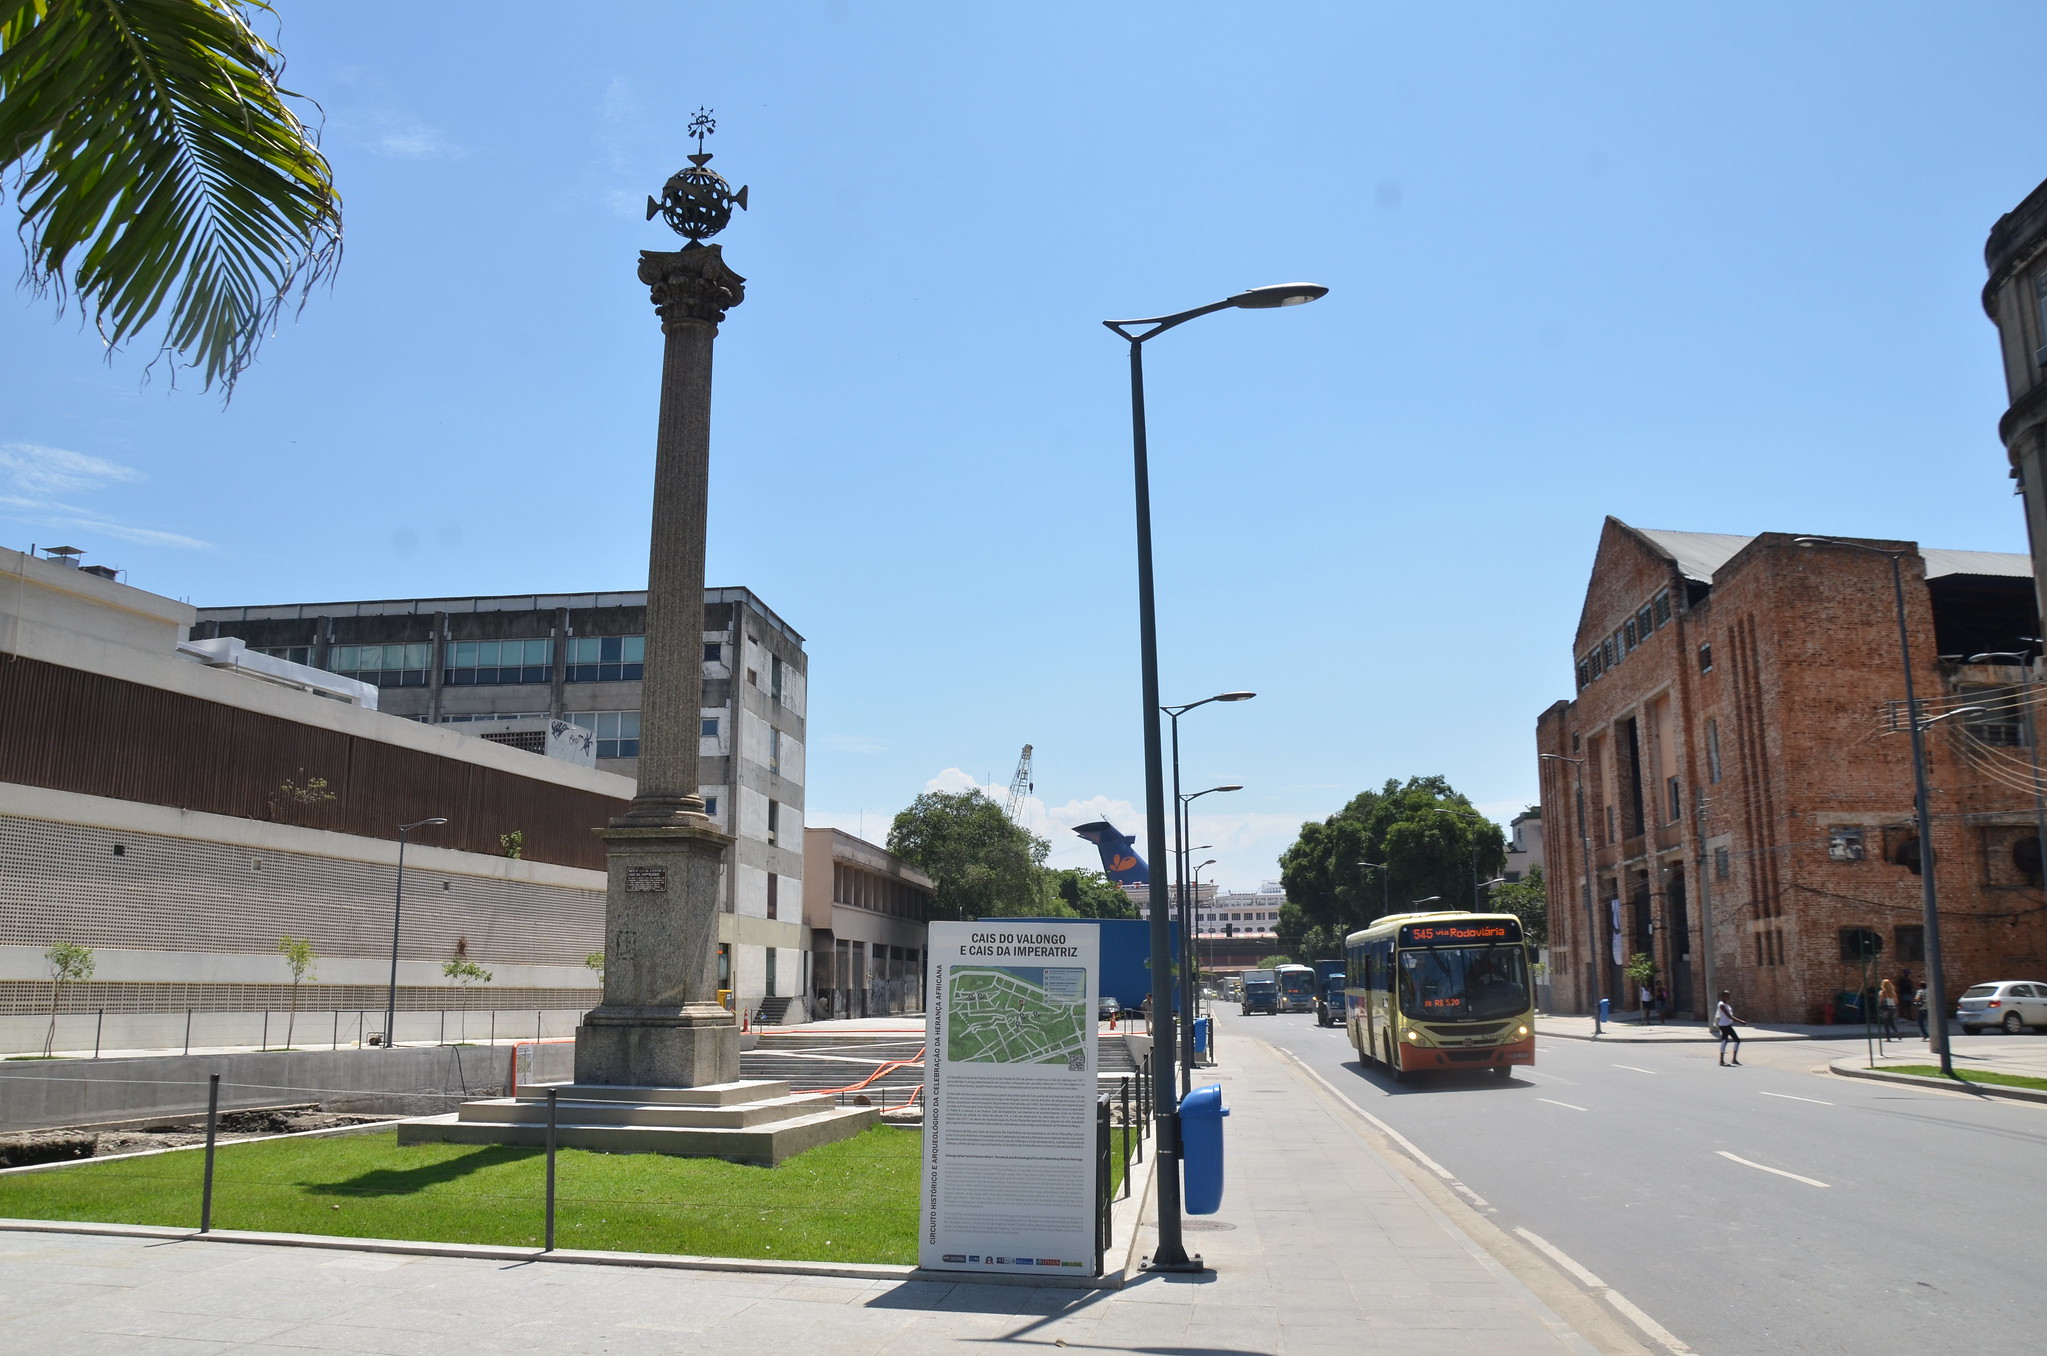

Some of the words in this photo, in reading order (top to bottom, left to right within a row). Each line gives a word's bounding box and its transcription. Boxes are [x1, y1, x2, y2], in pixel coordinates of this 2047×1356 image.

[971, 933, 996, 944] CAIS
[999, 933, 1014, 944] DO
[1016, 934, 1066, 945] VALONGO
[1413, 928, 1434, 940] 545
[1435, 928, 1449, 936] via
[1449, 926, 1505, 938] Rodoviária
[960, 945, 967, 956] E
[969, 945, 994, 956] CAIS
[996, 946, 1011, 956] DA
[1013, 946, 1078, 957] IMPERATRIZ
[935, 1001, 943, 1036] HERANÇA
[934, 1036, 941, 1047] DA
[933, 1048, 941, 1096] CELEBRAÇÃO
[933, 1097, 940, 1107] DA
[931, 1108, 939, 1164] ARQUEOLÓGICO
[929, 1171, 937, 1210] HISTÓRICO
